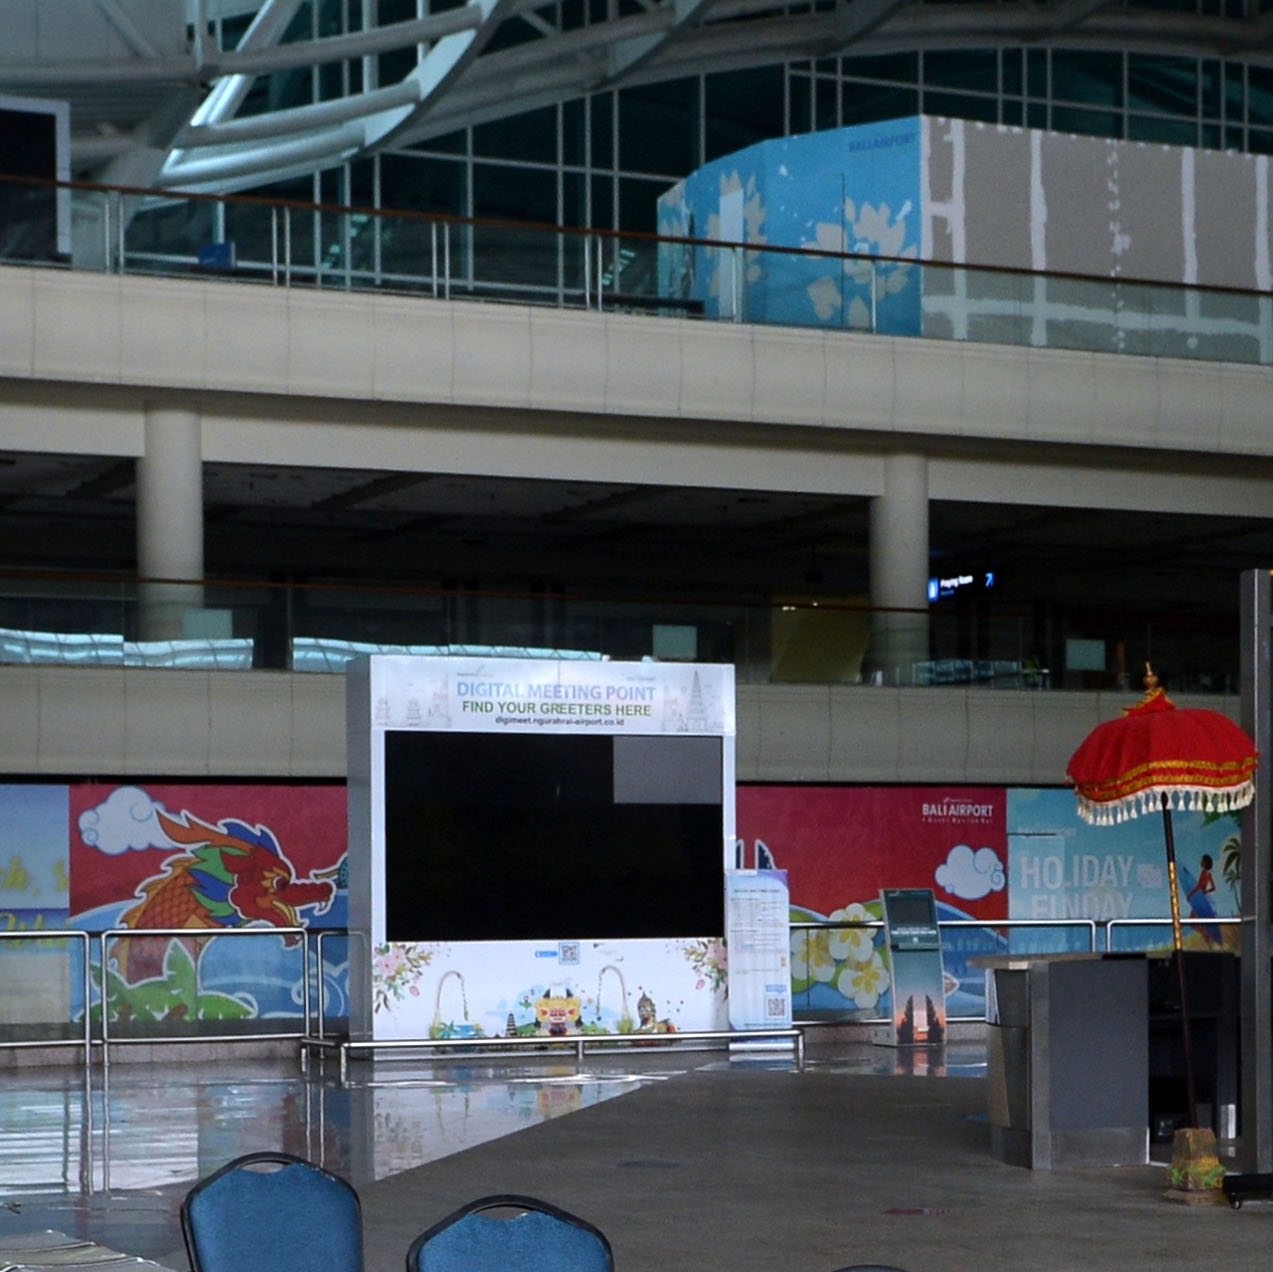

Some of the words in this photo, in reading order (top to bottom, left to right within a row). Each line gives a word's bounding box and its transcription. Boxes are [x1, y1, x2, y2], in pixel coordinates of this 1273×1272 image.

[457, 681, 524, 698] DIGITAL
[528, 683, 601, 700] MEETING
[606, 686, 656, 701] POINT
[462, 701, 494, 713] FIND
[497, 702, 536, 714] YOUR
[540, 703, 612, 716] GREETERS
[615, 704, 652, 717] HERE
[922, 803, 947, 816] BALI
[948, 804, 993, 817] AIRPORT
[1020, 854, 1135, 890] HOIDAY
